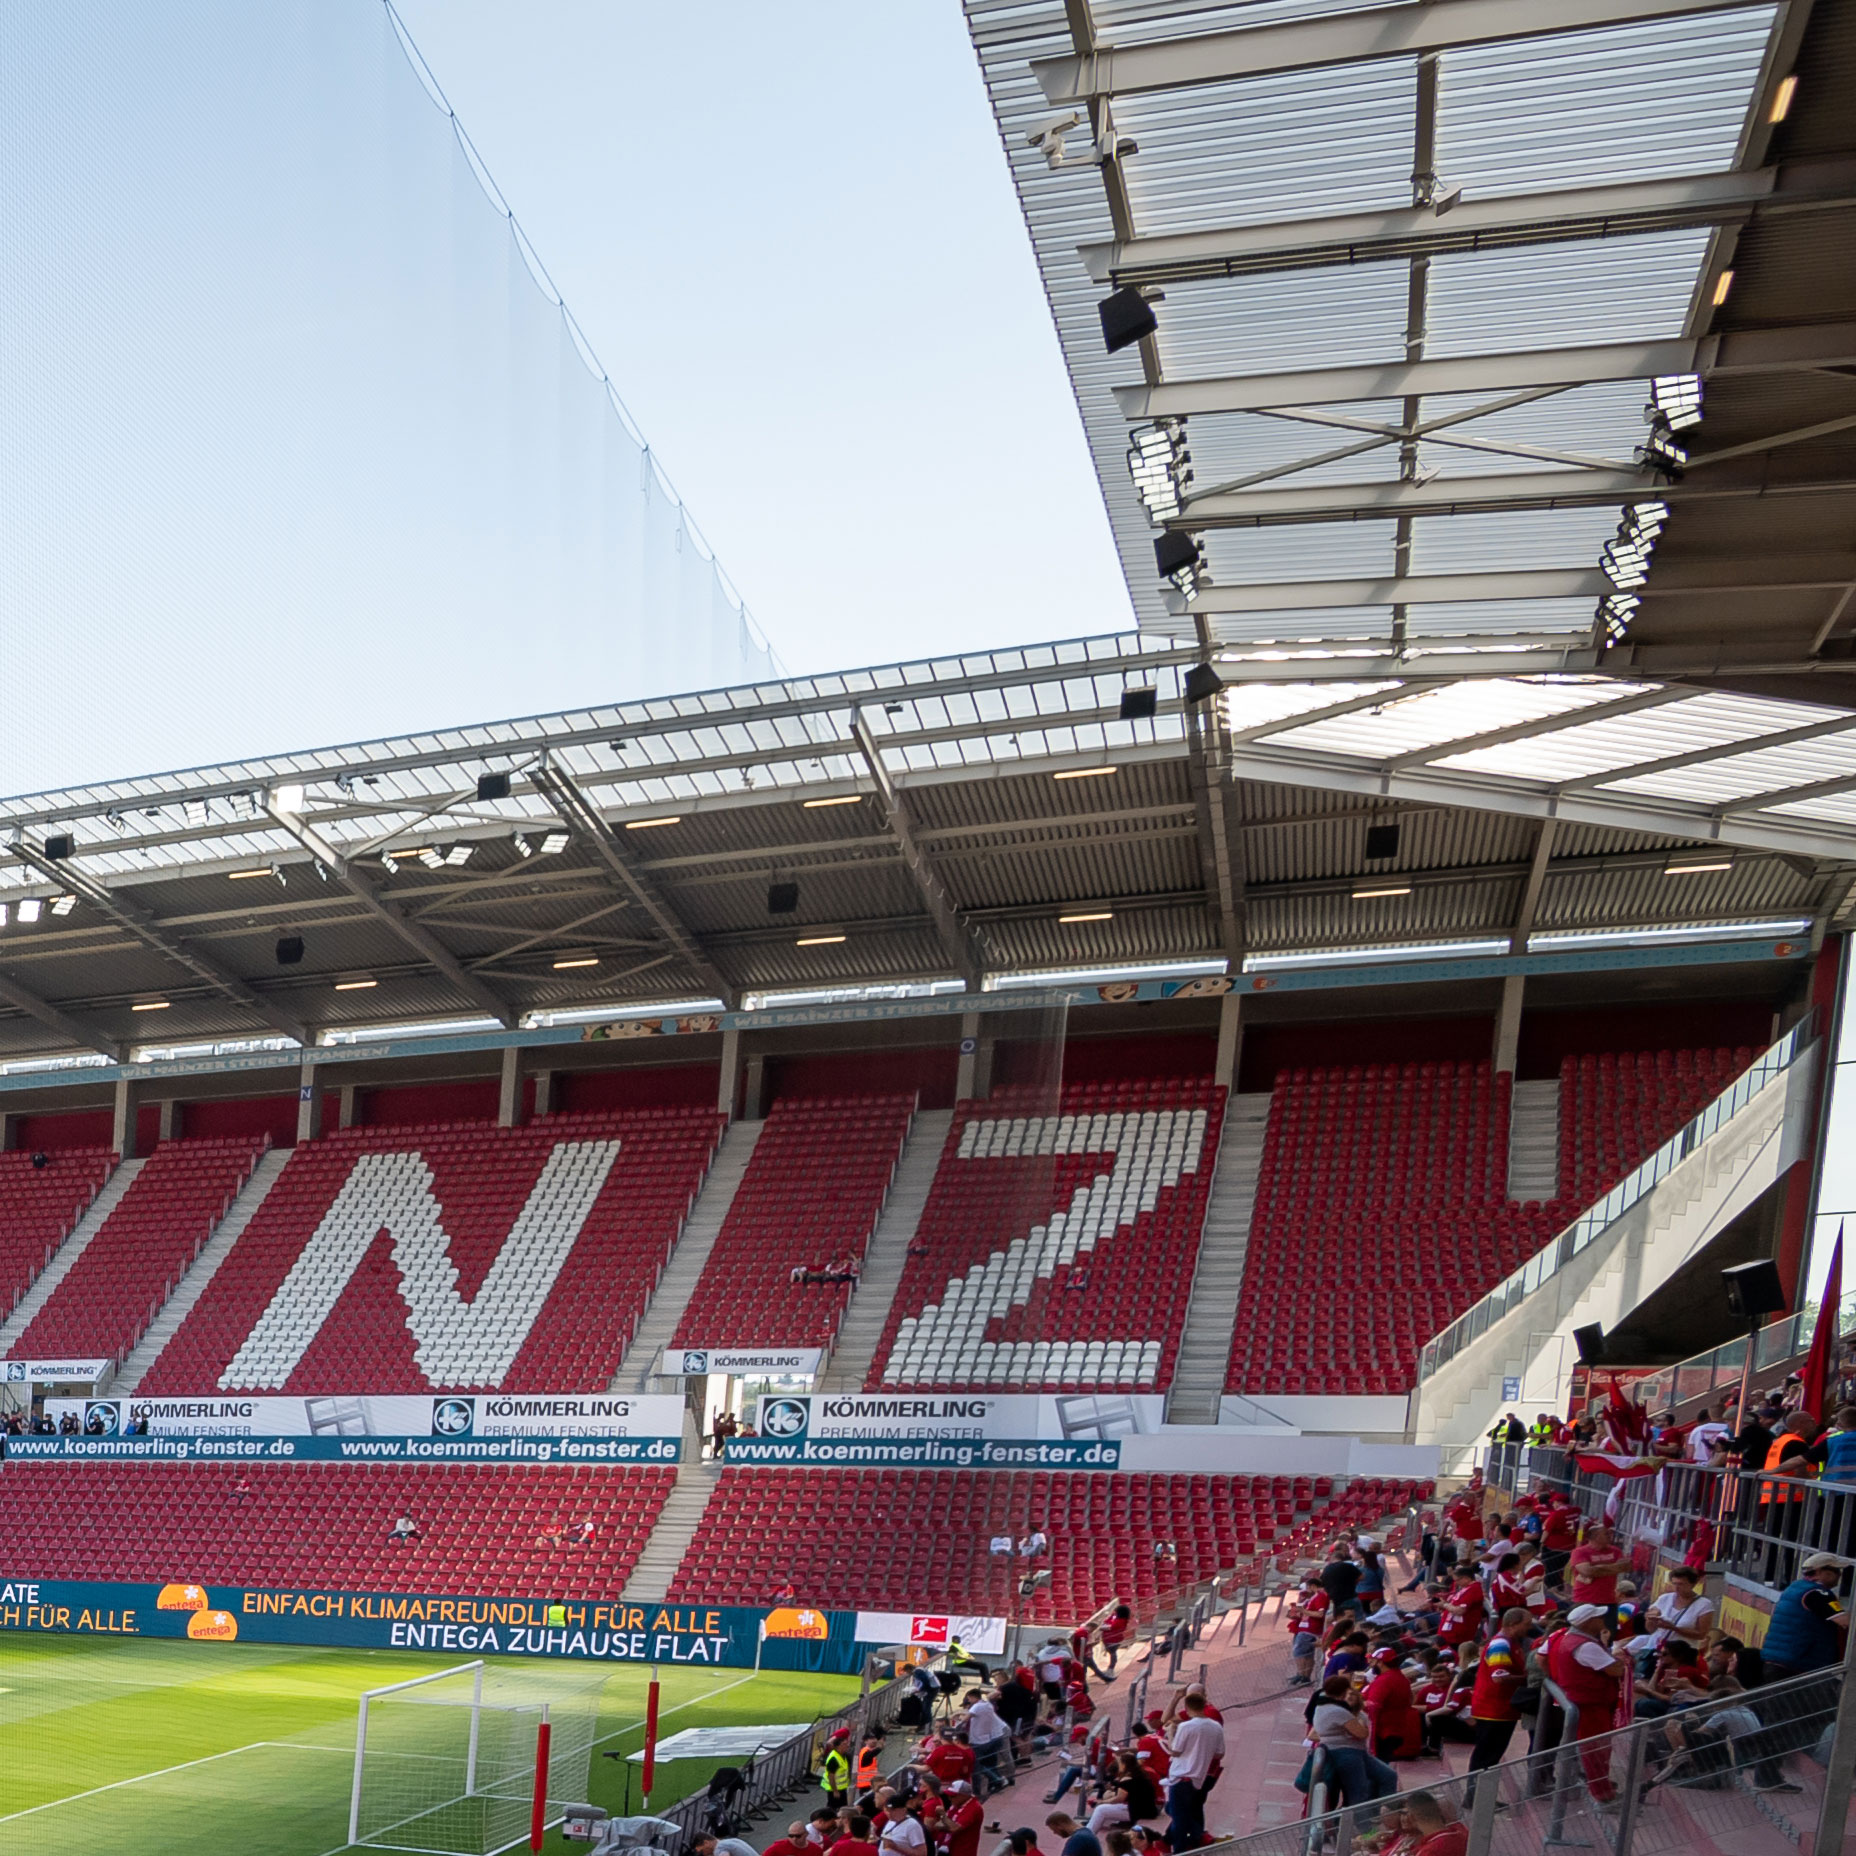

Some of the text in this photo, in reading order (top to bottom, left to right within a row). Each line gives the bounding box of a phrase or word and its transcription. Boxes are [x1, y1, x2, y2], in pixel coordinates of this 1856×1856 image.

[714, 1354, 800, 1366] KÖMMERLING
[30, 1365, 94, 1376] KÖMMERLING
[129, 1400, 252, 1417] KÖMMERLING
[485, 1397, 629, 1417] KÖMMERLING
[822, 1396, 986, 1418] KÖMMERLING
[147, 1426, 251, 1436] EMIUM FENSTER
[483, 1425, 628, 1437] PREMIUM FENSTER
[820, 1426, 983, 1439] PREMIUM FENSTER
[8, 1438, 294, 1457] www.koemmerling-fenster.de
[341, 1439, 677, 1459] www.koemmerling-fenster.de
[728, 1441, 1118, 1464] www.koemmerling-fenster.de
[27, 1604, 70, 1629] FÜR
[78, 1609, 140, 1633] ALLE.
[242, 1593, 721, 1634] EINFACH KLIMAFREUNDLIH FÜR ALLE
[193, 1625, 231, 1637] entega
[391, 1622, 728, 1662] ENTEGA ZUHAUSE FLAT
